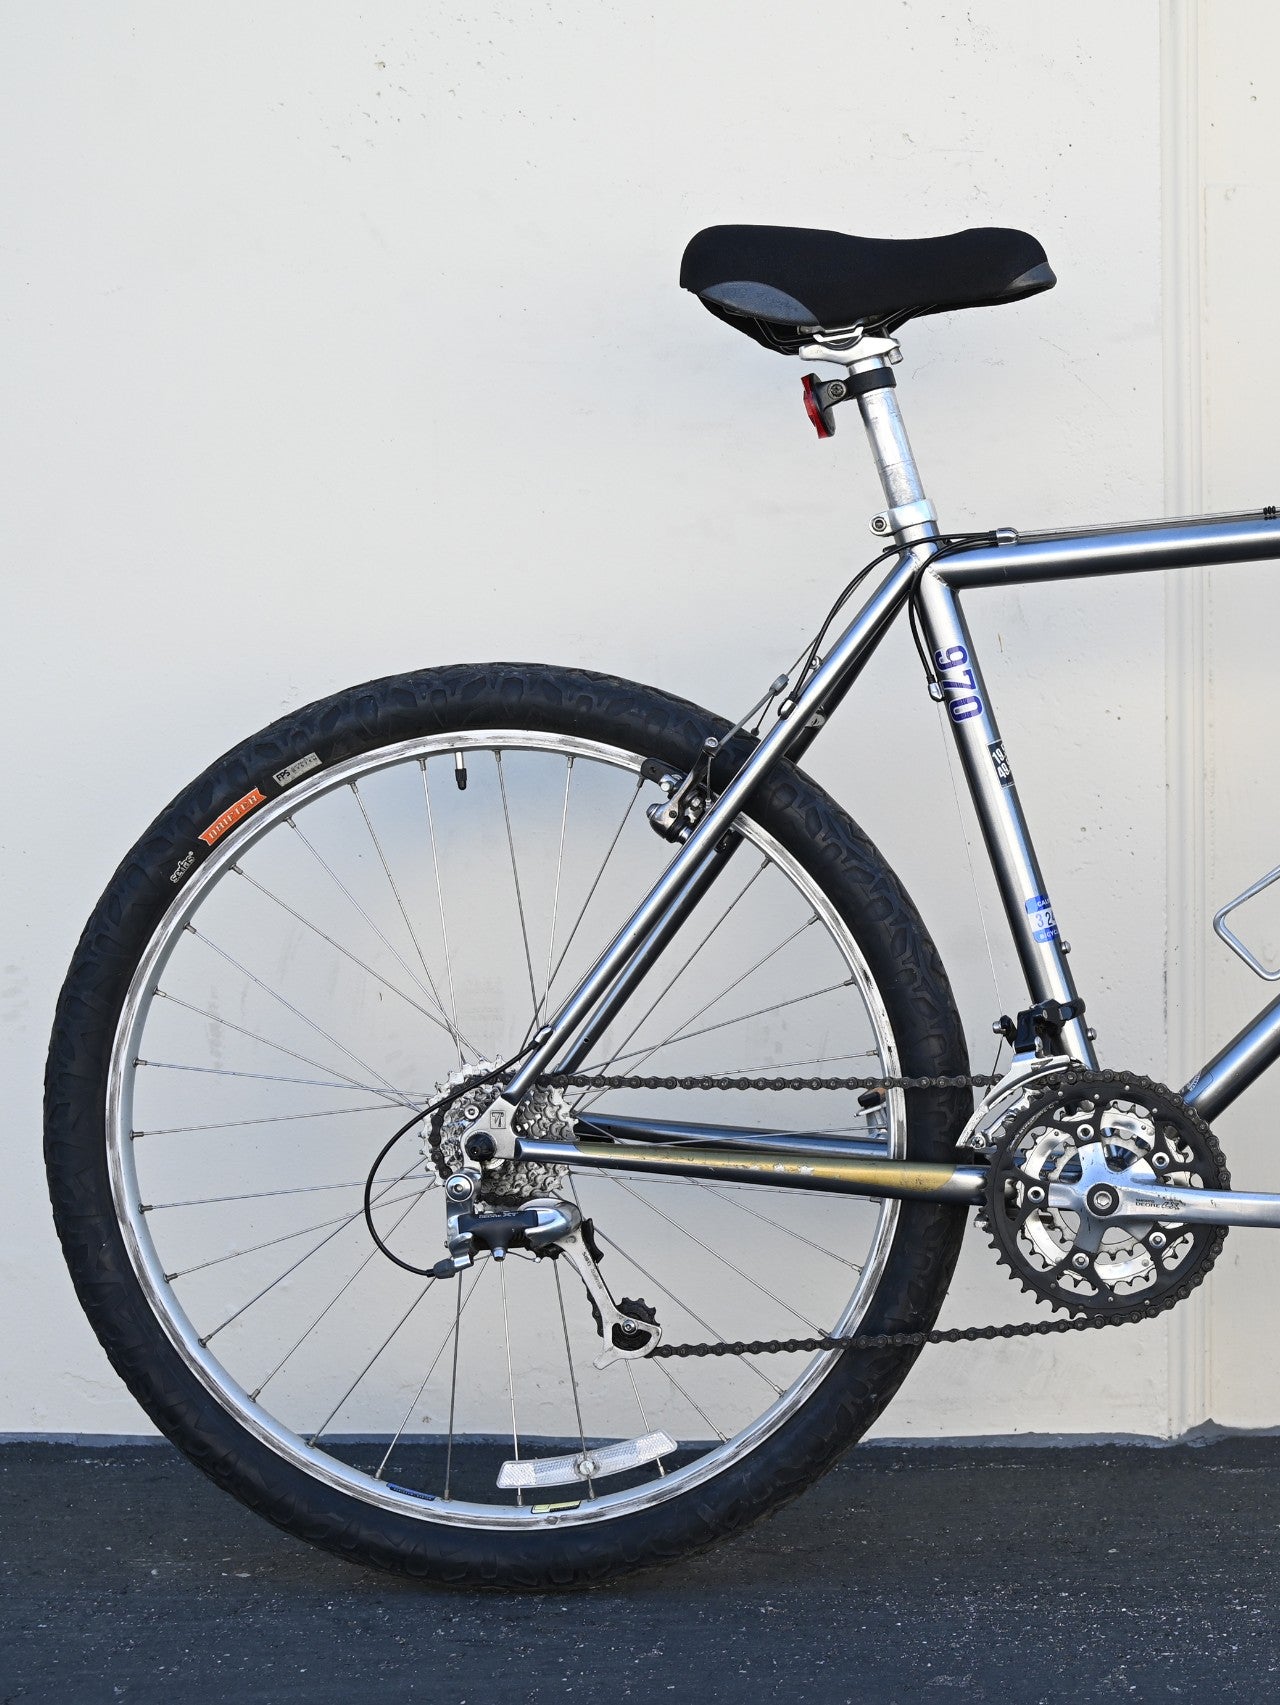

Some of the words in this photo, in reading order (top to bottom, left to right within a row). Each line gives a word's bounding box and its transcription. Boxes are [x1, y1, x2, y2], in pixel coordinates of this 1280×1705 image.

[934, 645, 983, 722] 970
[275, 769, 291, 783] FPS
[208, 795, 258, 840] DRIFTER
